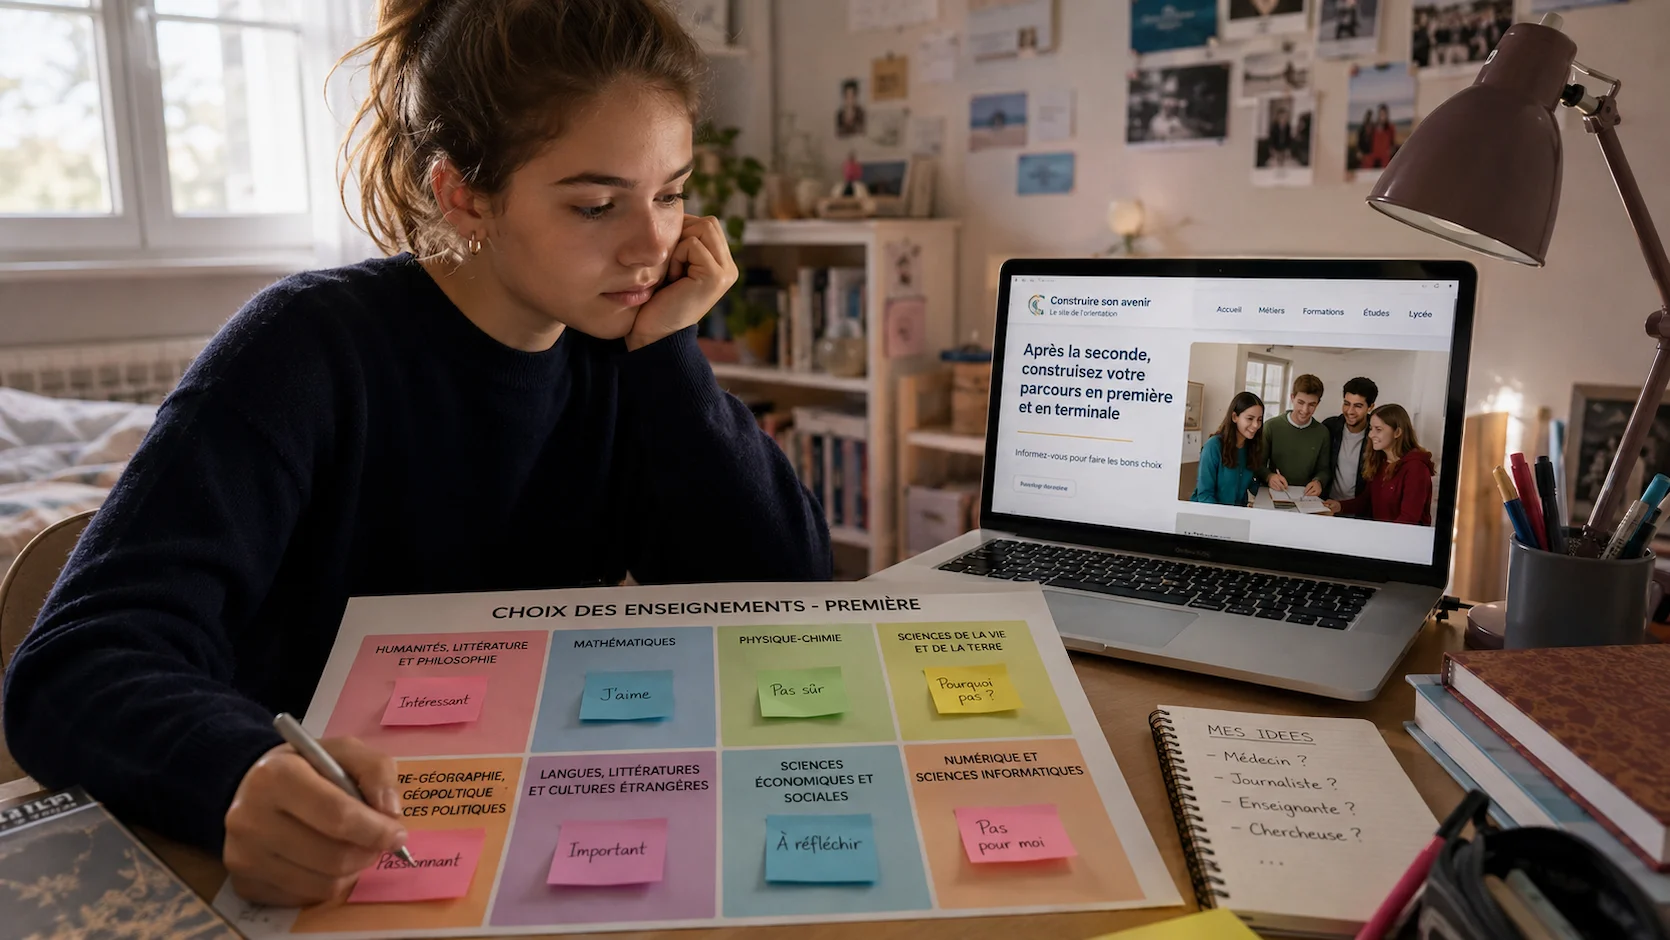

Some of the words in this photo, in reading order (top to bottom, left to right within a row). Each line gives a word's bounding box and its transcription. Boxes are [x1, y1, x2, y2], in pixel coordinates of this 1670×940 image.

[1050, 296, 1099, 306] Construire
[1121, 298, 1151, 307] avenir
[1216, 305, 1242, 314] Accueil
[1258, 306, 1285, 315] Métiers
[1302, 308, 1344, 316] Formations
[1363, 308, 1390, 317] Études
[1023, 343, 1064, 360] Après
[1068, 344, 1080, 358] la
[1084, 348, 1151, 364] seconde,
[1022, 364, 1102, 379] construisez
[1107, 368, 1146, 381] votre
[1020, 384, 1082, 398] parcours
[1085, 388, 1102, 399] en
[1106, 388, 1173, 404] première
[1018, 402, 1032, 414] et
[1035, 404, 1051, 415] en
[1055, 403, 1120, 420] terminale
[1015, 448, 1068, 462] Informez-vous
[1088, 454, 1106, 464] faire
[1108, 456, 1118, 466] les
[1120, 458, 1139, 468] bons
[1140, 460, 1162, 470] choix
[492, 604, 568, 619] CHOIX
[574, 604, 617, 617] DES
[624, 600, 806, 617] ENSEIGNEMENTS
[825, 596, 921, 612] PREMIÈRE
[574, 636, 676, 648] MATHÉMATIQUES
[739, 634, 842, 644] PHYSIQUE-CHIMIE
[898, 631, 952, 642] SCIENCES
[954, 631, 970, 640] DE
[972, 630, 988, 640] LA
[989, 630, 1006, 640] VIE
[376, 641, 450, 654] HUMANITÉS,
[453, 640, 528, 652] LITTÉRATURE
[914, 644, 930, 653] ET
[932, 644, 948, 652] DE
[950, 644, 965, 652] LA
[967, 642, 1003, 652] TERRE
[398, 657, 415, 666] ET
[416, 655, 497, 666] PHILOSOPHIE
[770, 683, 796, 697] Pas
[802, 684, 825, 696] sûr
[936, 677, 994, 692] Pourquoi
[398, 694, 470, 708] Intéressant
[600, 686, 651, 701] J'aime
[958, 693, 982, 706] pas
[986, 689, 994, 701] ?
[1208, 724, 1246, 738] MES
[1256, 728, 1314, 743] IDEES
[780, 760, 844, 771] SCIENCES
[944, 752, 1021, 766] NUMÉRIQUE
[1023, 752, 1038, 762] ET
[1224, 751, 1292, 766] Médecin
[1296, 754, 1308, 767] ?
[540, 768, 605, 780] LANGUES,
[608, 764, 700, 778] LITTÉRATURES
[916, 770, 978, 782] SCIENCES
[981, 766, 1084, 780] INFORMATIQUES
[755, 775, 854, 788] ÉCONOMIQUES
[858, 774, 873, 784] ET
[1230, 772, 1322, 790] Journaliste
[1326, 778, 1338, 790] ?
[528, 785, 546, 796] ET
[548, 784, 616, 796] CULTURES
[784, 792, 848, 803] SOCIALES
[402, 806, 428, 817] CES
[431, 804, 506, 816] POLITIQUES
[1238, 796, 1340, 818] Enseignante
[1344, 802, 1356, 816] ?
[975, 819, 1008, 835] Pas
[1249, 822, 1348, 842] Chercheuse
[1350, 827, 1362, 843] ?
[776, 830, 788, 851] À
[795, 835, 862, 854] réfléchir
[978, 841, 1011, 856] pour
[1018, 836, 1046, 849] moi
[567, 841, 647, 864] Important
